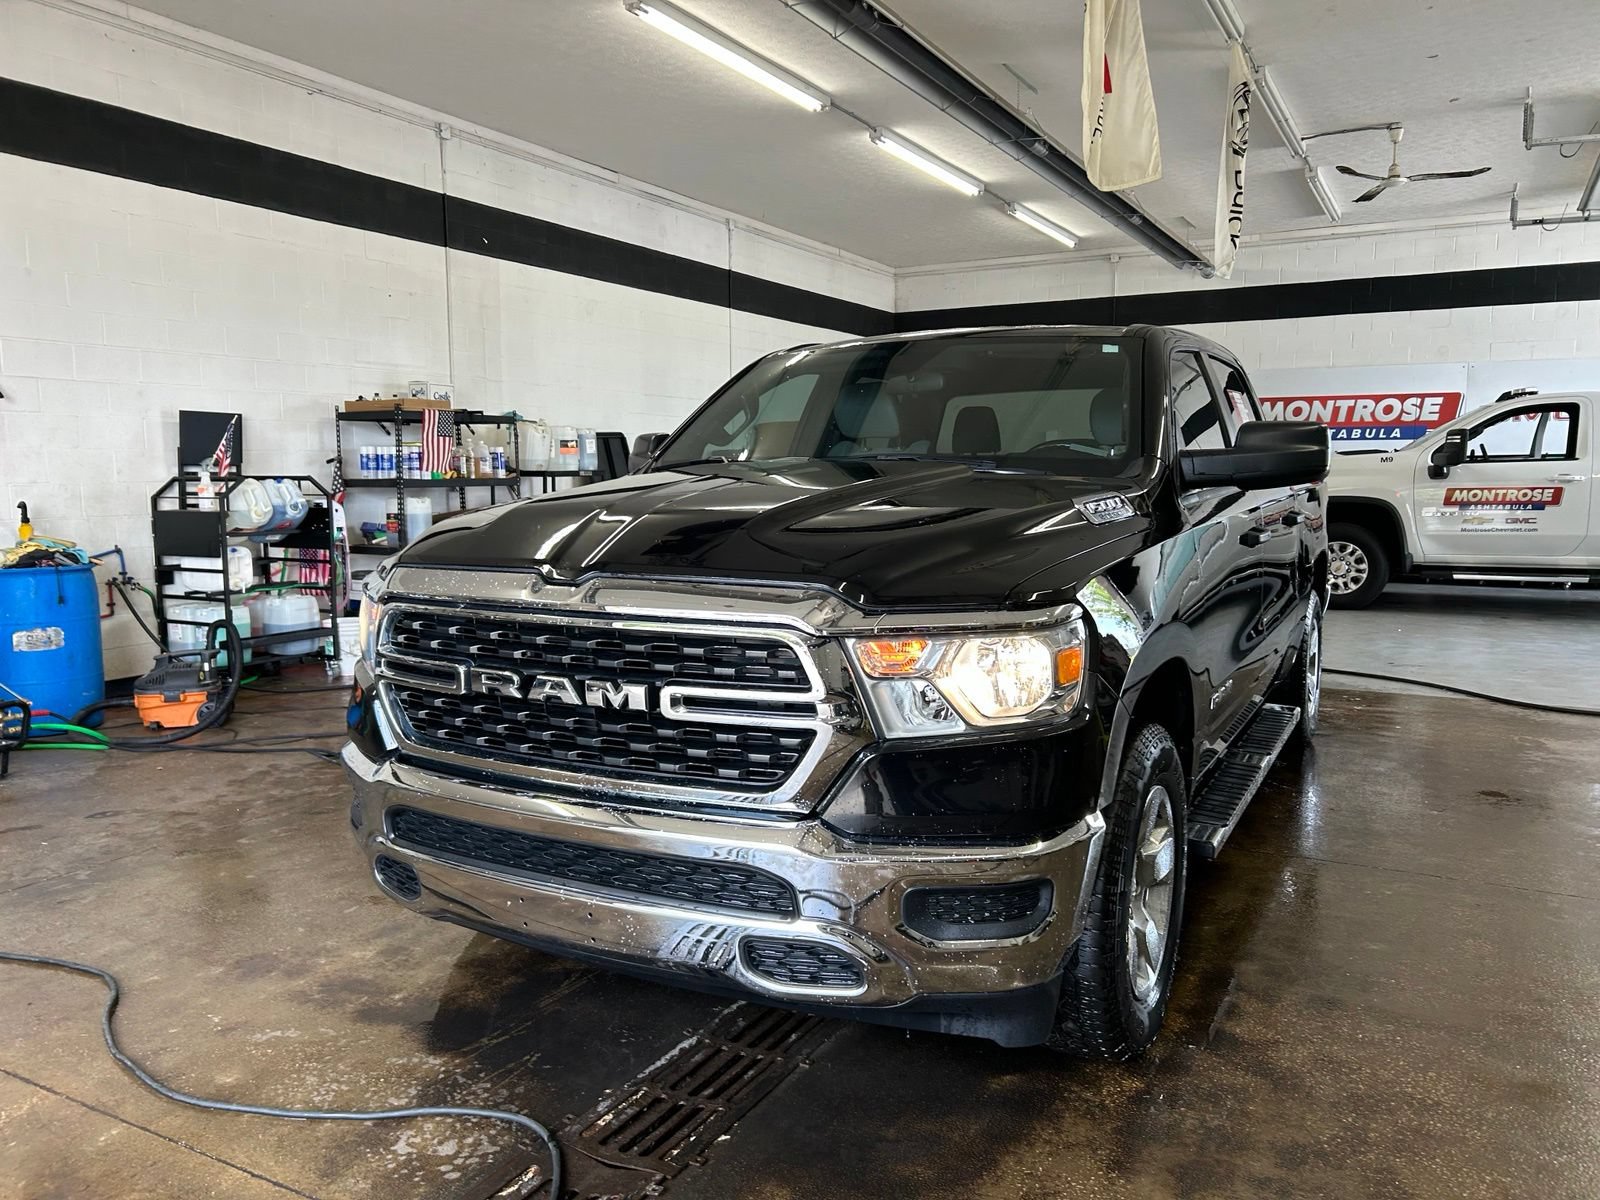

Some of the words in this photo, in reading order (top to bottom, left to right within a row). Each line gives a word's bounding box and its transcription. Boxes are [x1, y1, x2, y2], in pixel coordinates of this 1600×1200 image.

[1262, 397, 1443, 423] MONTROSE
[1328, 428, 1401, 439] TABULA
[1380, 456, 1394, 464] M9
[1451, 489, 1554, 502] MONTROSE
[469, 668, 649, 711] RAM
